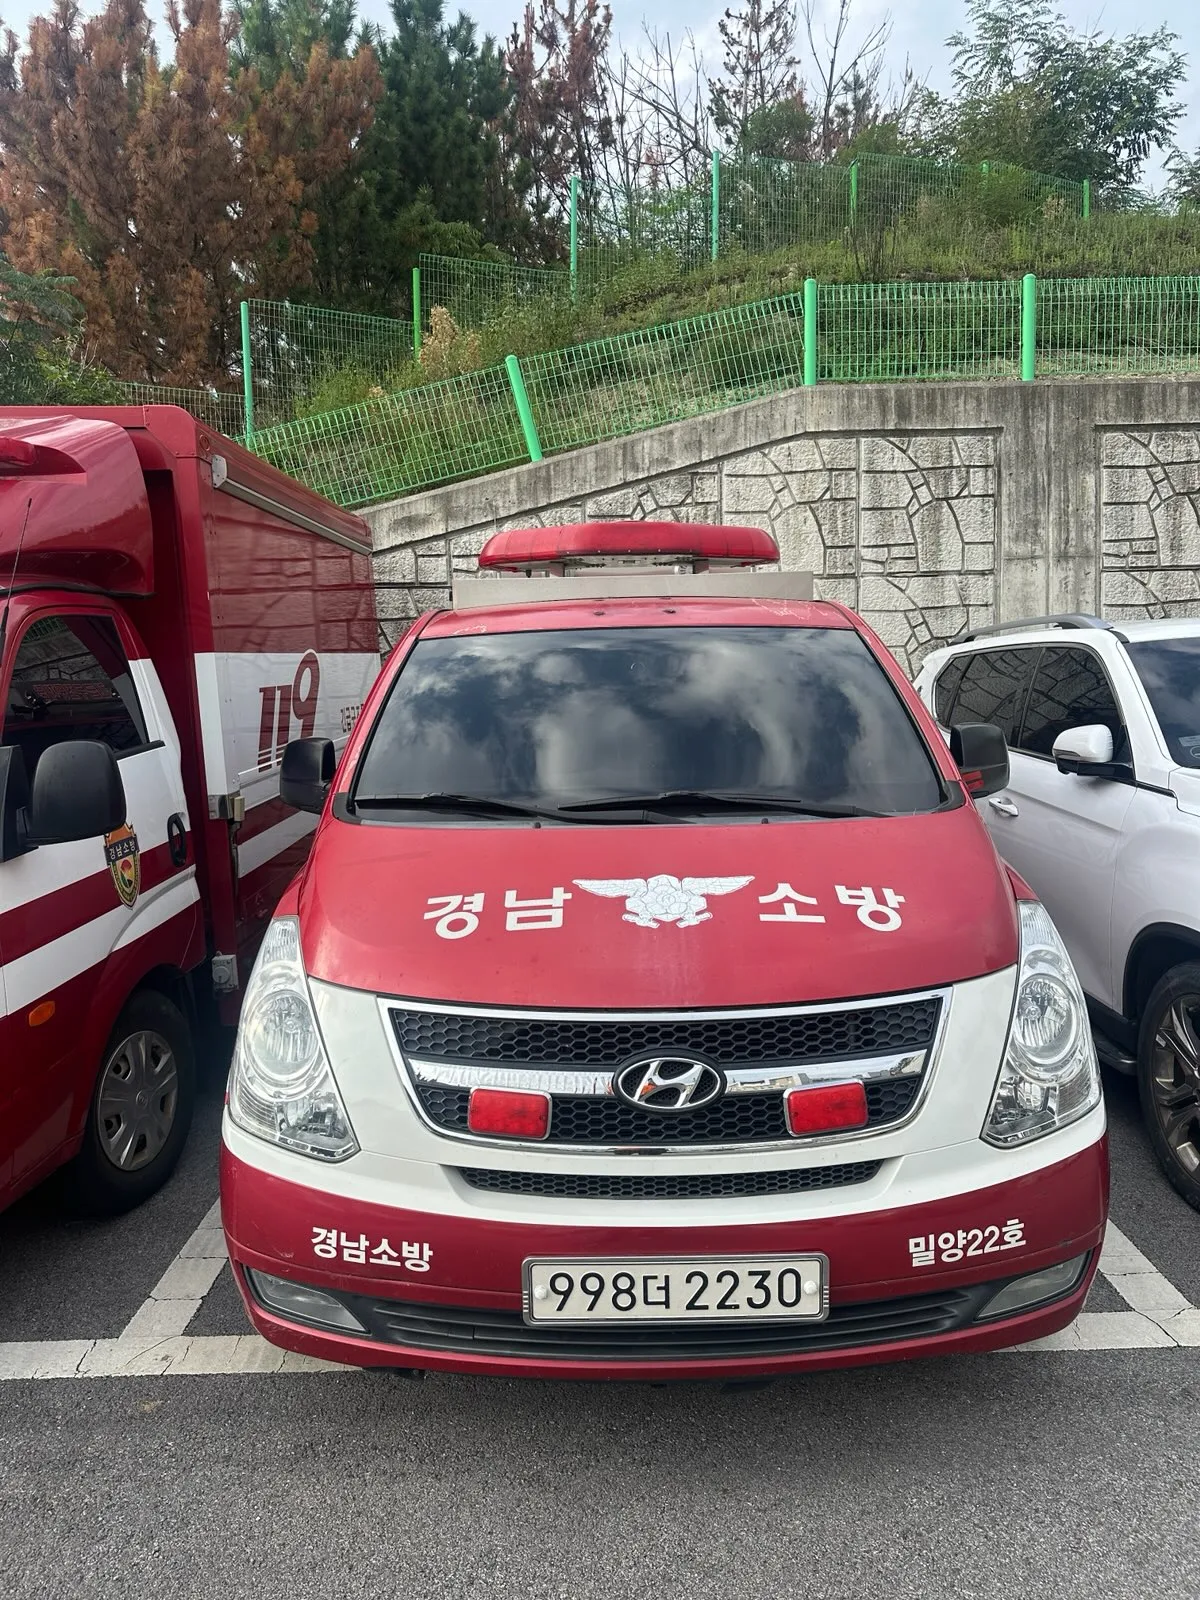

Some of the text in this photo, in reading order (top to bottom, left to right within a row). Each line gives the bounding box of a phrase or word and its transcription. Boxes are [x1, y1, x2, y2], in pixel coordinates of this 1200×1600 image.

[258, 651, 319, 773] 119
[109, 841, 136, 860] 경남소방
[758, 882, 906, 932] 소방
[311, 1226, 433, 1272] 경남소방
[909, 1218, 1026, 1267] 밀양22호
[685, 1267, 802, 1310] 2230
